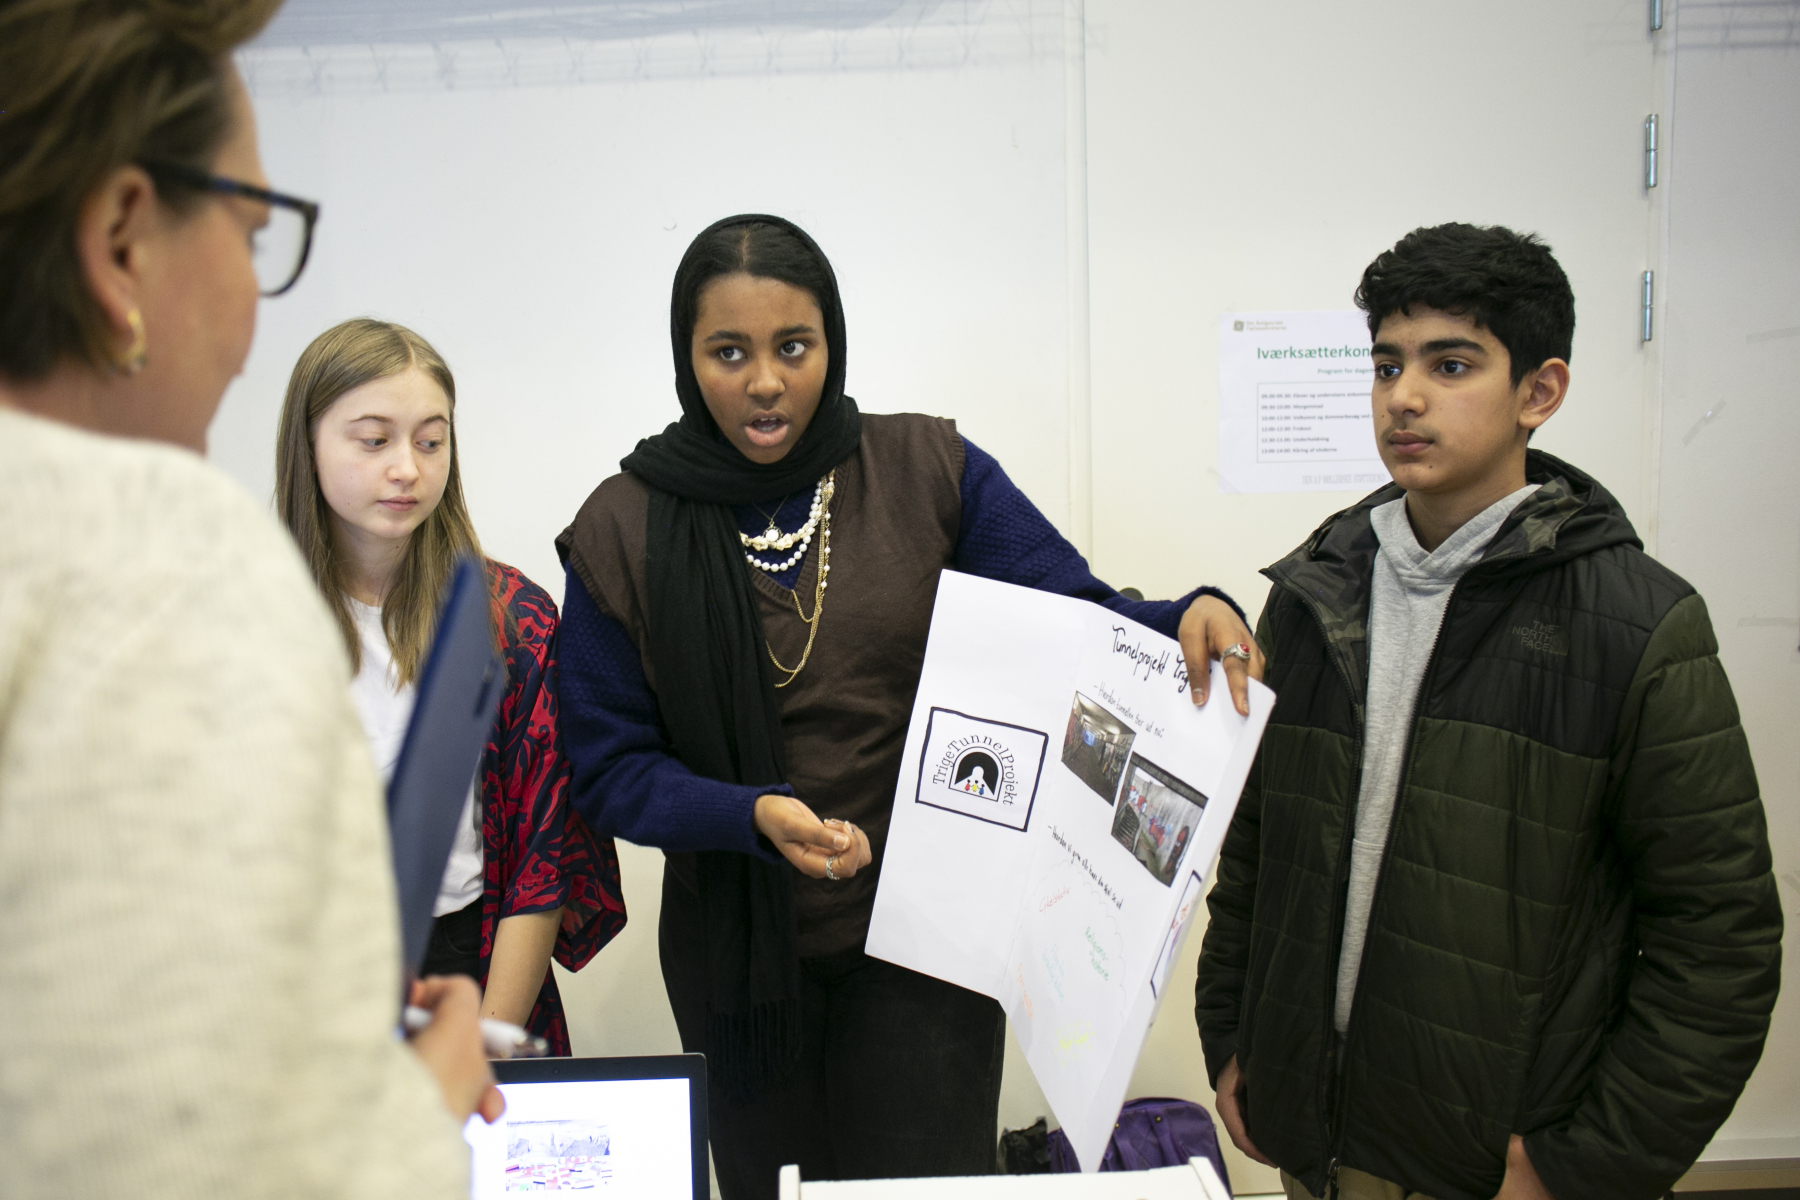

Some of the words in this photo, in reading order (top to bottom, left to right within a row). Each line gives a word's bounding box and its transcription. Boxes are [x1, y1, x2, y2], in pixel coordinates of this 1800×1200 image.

[1257, 345, 1370, 359] Iværksætterkon
[1511, 626, 1553, 644] NORTH
[1533, 620, 1555, 633] THE
[1112, 624, 1170, 681] Tunnelprojekt
[1521, 636, 1550, 652] FACE
[932, 734, 1019, 806] TrigeTunnelProjekt
